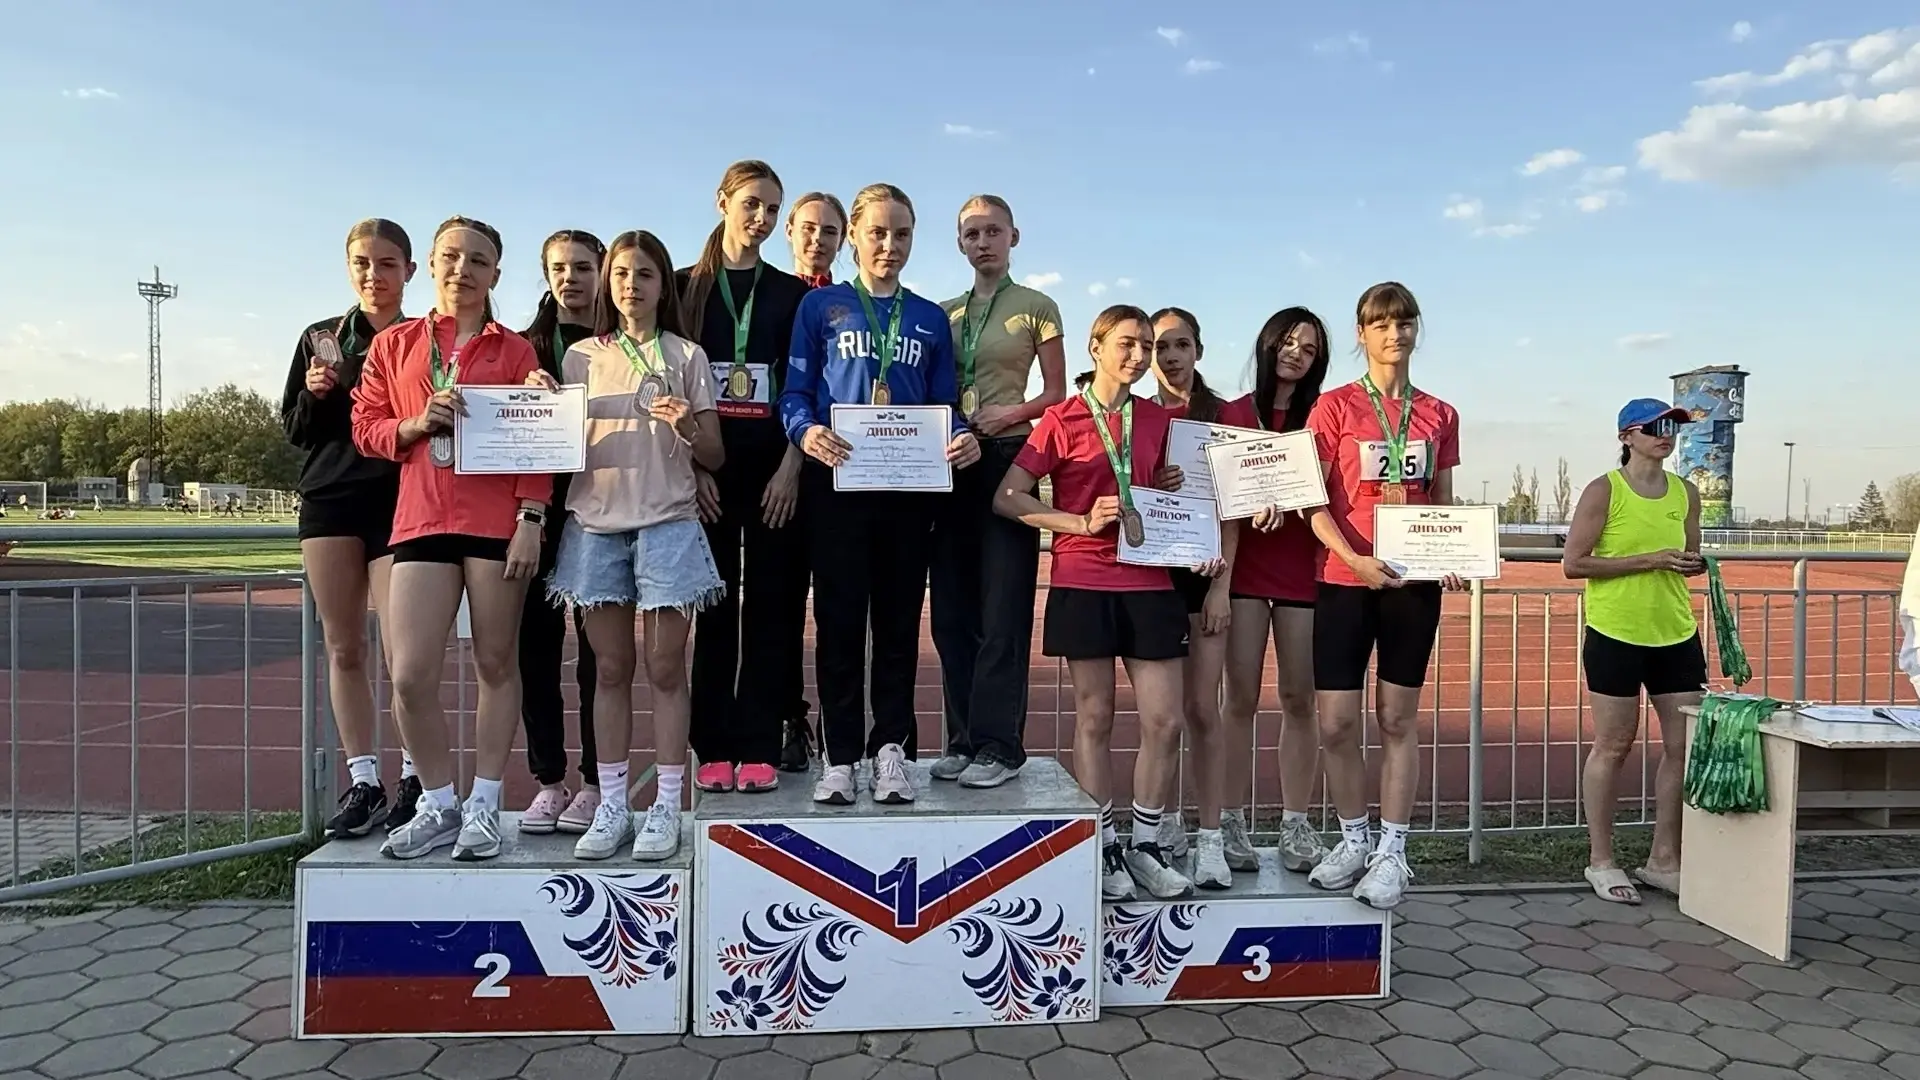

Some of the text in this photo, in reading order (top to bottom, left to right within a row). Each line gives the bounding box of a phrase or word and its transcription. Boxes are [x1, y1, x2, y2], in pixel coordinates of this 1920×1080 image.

[837, 330, 922, 368] RUSSIA
[720, 377, 758, 400] 27
[495, 408, 553, 419] ДИПЛОМ
[866, 427, 918, 438] ДИПЛОМ
[1240, 453, 1287, 469] ДИПЛОМ
[1378, 455, 1416, 477] 25
[1146, 508, 1191, 521] ДИПЛОМ
[1407, 524, 1462, 534] ДИПЛОМ
[876, 856, 919, 927] 1
[1242, 945, 1271, 982] 3
[472, 953, 511, 998] 2
